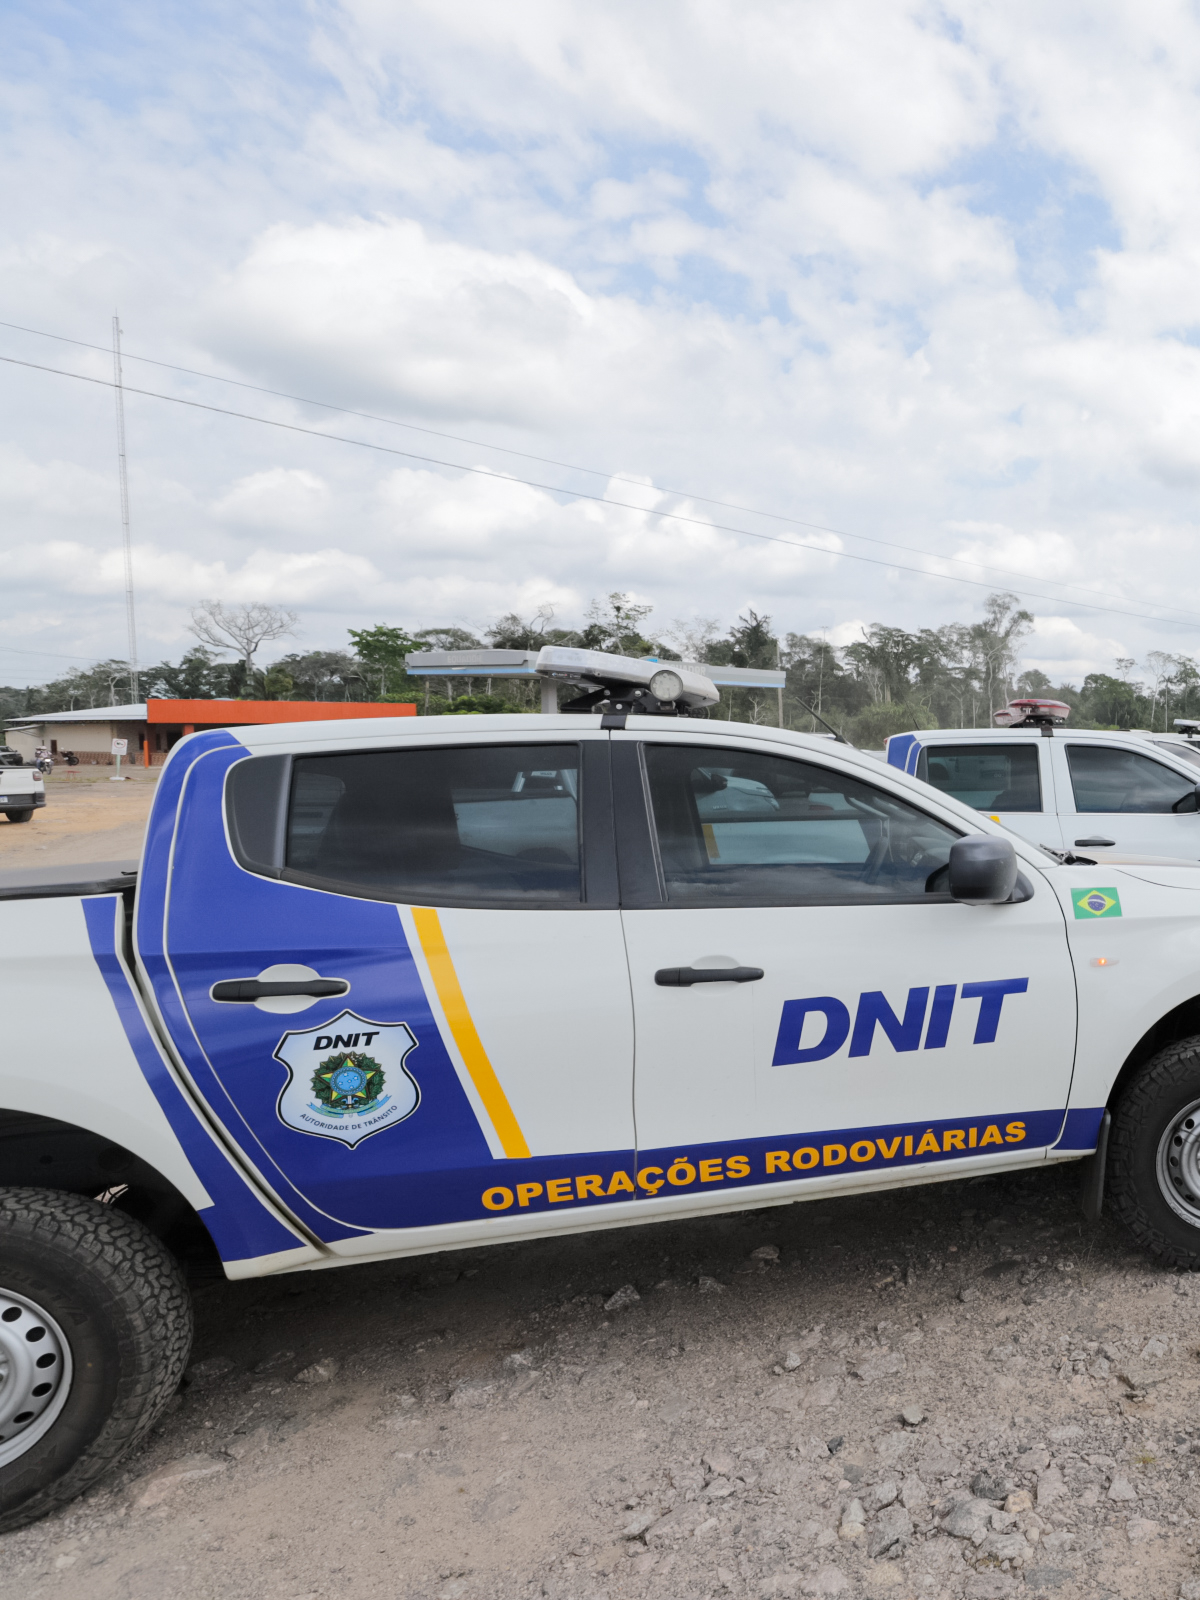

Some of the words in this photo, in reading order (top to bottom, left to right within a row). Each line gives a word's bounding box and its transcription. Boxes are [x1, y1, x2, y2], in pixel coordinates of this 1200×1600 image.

[313, 1031, 380, 1050] DNIT
[771, 977, 1030, 1067] DNIT
[299, 1113, 350, 1131] AUTORIDADE
[364, 1105, 398, 1128] TRÂNSITO
[481, 1156, 751, 1211] OPERAÇÕES
[765, 1121, 1027, 1174] RODOVIÁRIAS
